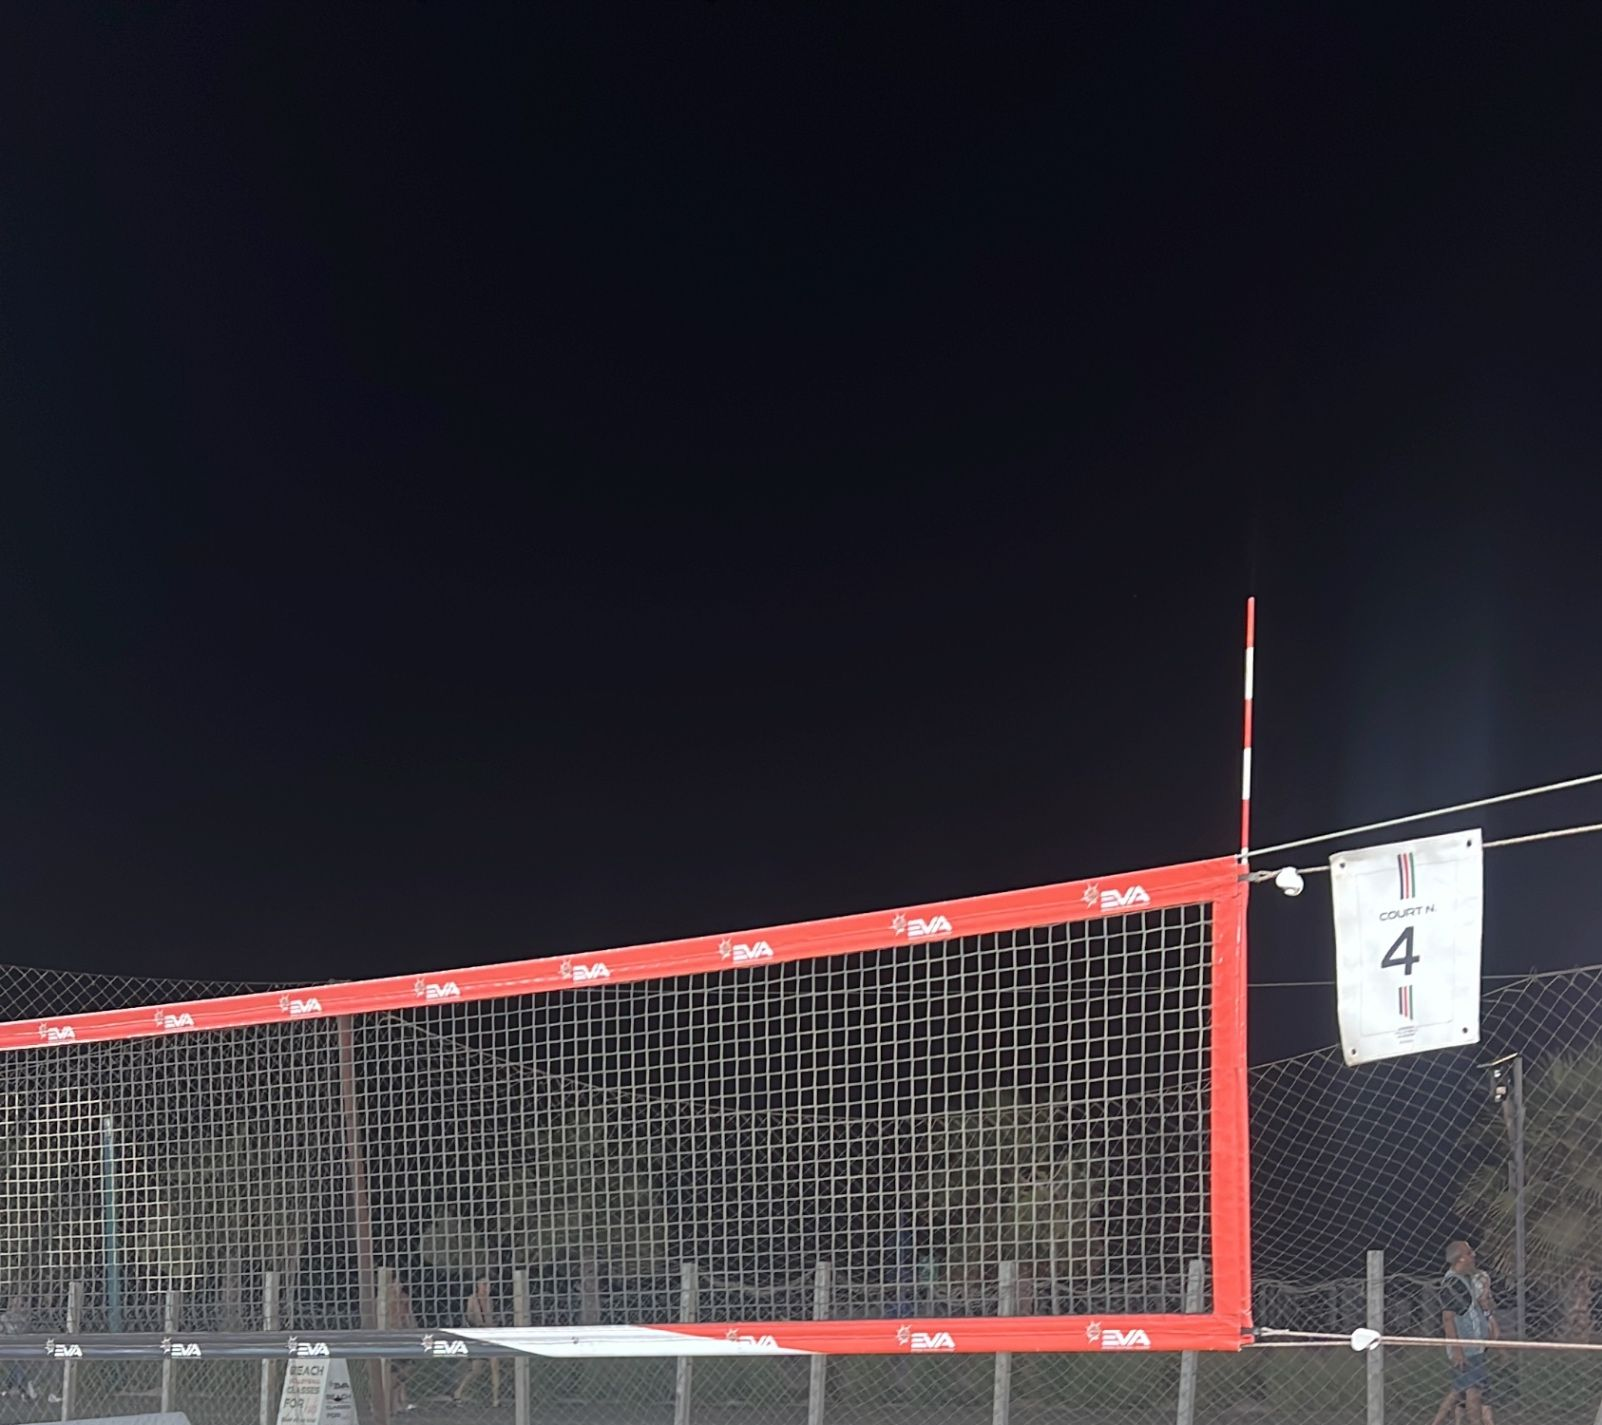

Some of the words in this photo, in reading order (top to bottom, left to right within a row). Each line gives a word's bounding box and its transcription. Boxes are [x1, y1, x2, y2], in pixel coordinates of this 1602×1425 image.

[1100, 885, 1150, 909] EVA
[1379, 906, 1423, 921] COURT
[907, 915, 952, 937] EVA
[732, 941, 773, 961] EVA
[1381, 926, 1420, 976] 4
[573, 963, 610, 982] EVA
[426, 982, 460, 999] EVA
[290, 998, 322, 1014] EVA
[164, 1013, 194, 1029] EVA
[48, 1026, 76, 1040] EVA
[911, 1333, 955, 1349] EVA
[1102, 1329, 1150, 1349] EVA
[54, 1344, 83, 1357] EVA
[171, 1343, 201, 1356] EVA
[297, 1343, 330, 1356] EVA
[432, 1341, 469, 1355] EVA
[289, 1365, 324, 1376] BEACH
[283, 1398, 304, 1408] FOR
